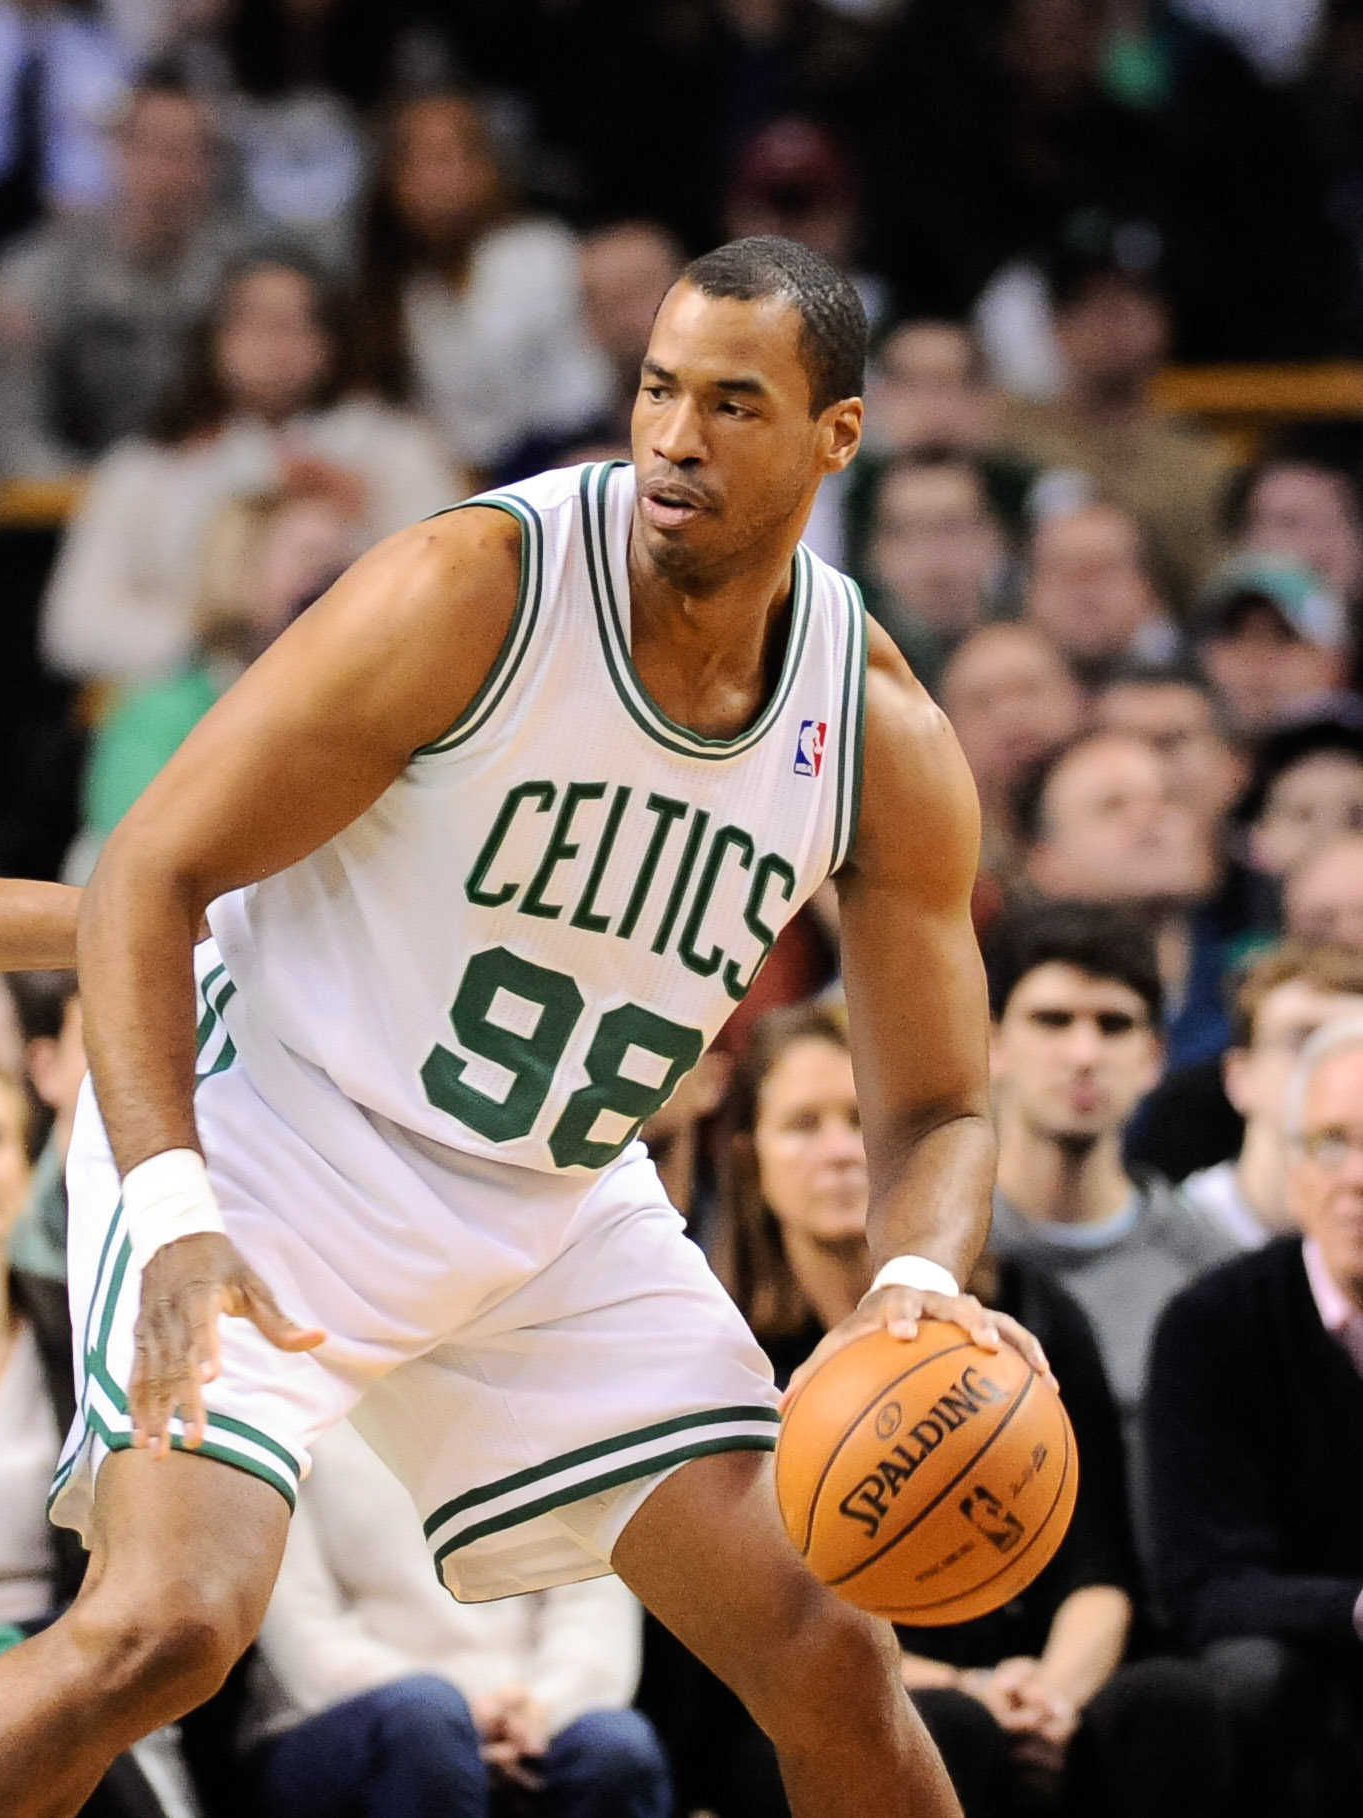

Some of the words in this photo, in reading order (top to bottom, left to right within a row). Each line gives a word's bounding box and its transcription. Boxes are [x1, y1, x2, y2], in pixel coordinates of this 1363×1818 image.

[464, 780, 796, 1001] CELTICS
[420, 946, 703, 1169] 98
[839, 1366, 1009, 1539] SPALDING
